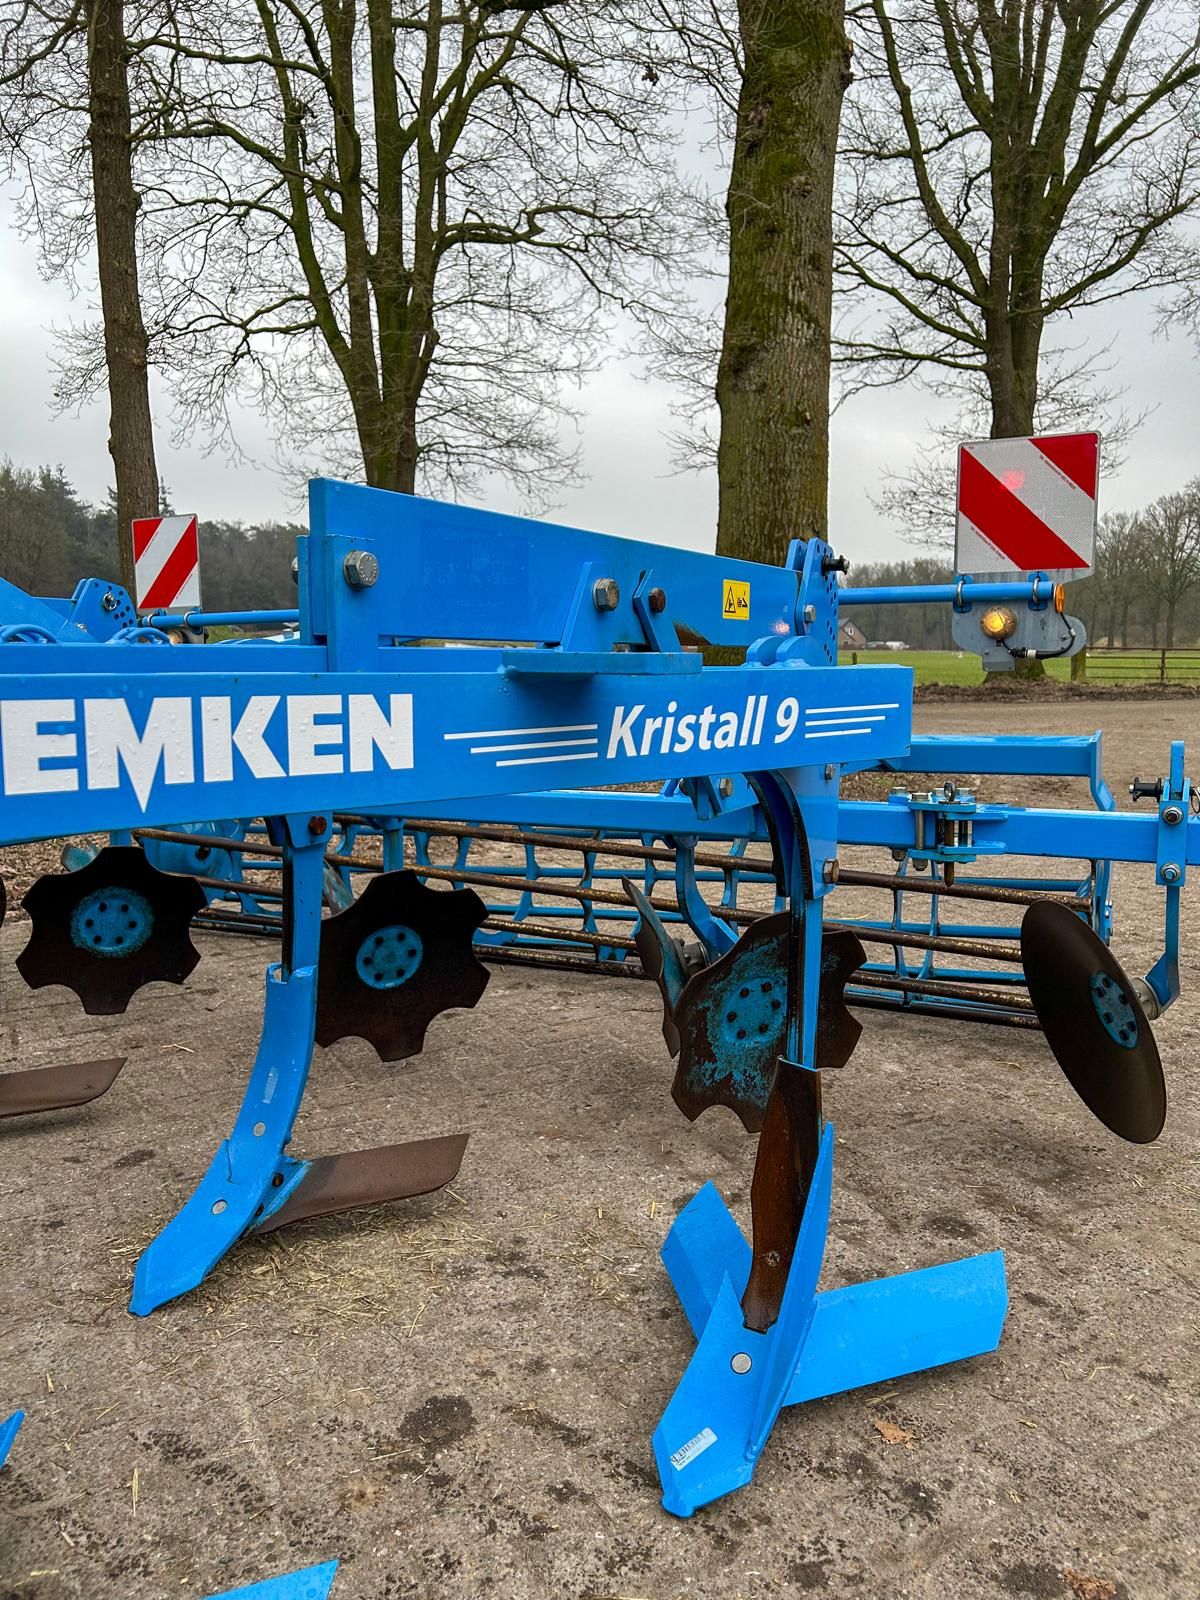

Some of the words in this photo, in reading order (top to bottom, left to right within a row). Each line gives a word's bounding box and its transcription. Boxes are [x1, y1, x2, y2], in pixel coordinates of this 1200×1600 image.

[0, 694, 414, 813] EMKEN
[606, 695, 769, 759] Kristall
[774, 697, 800, 744] 9
